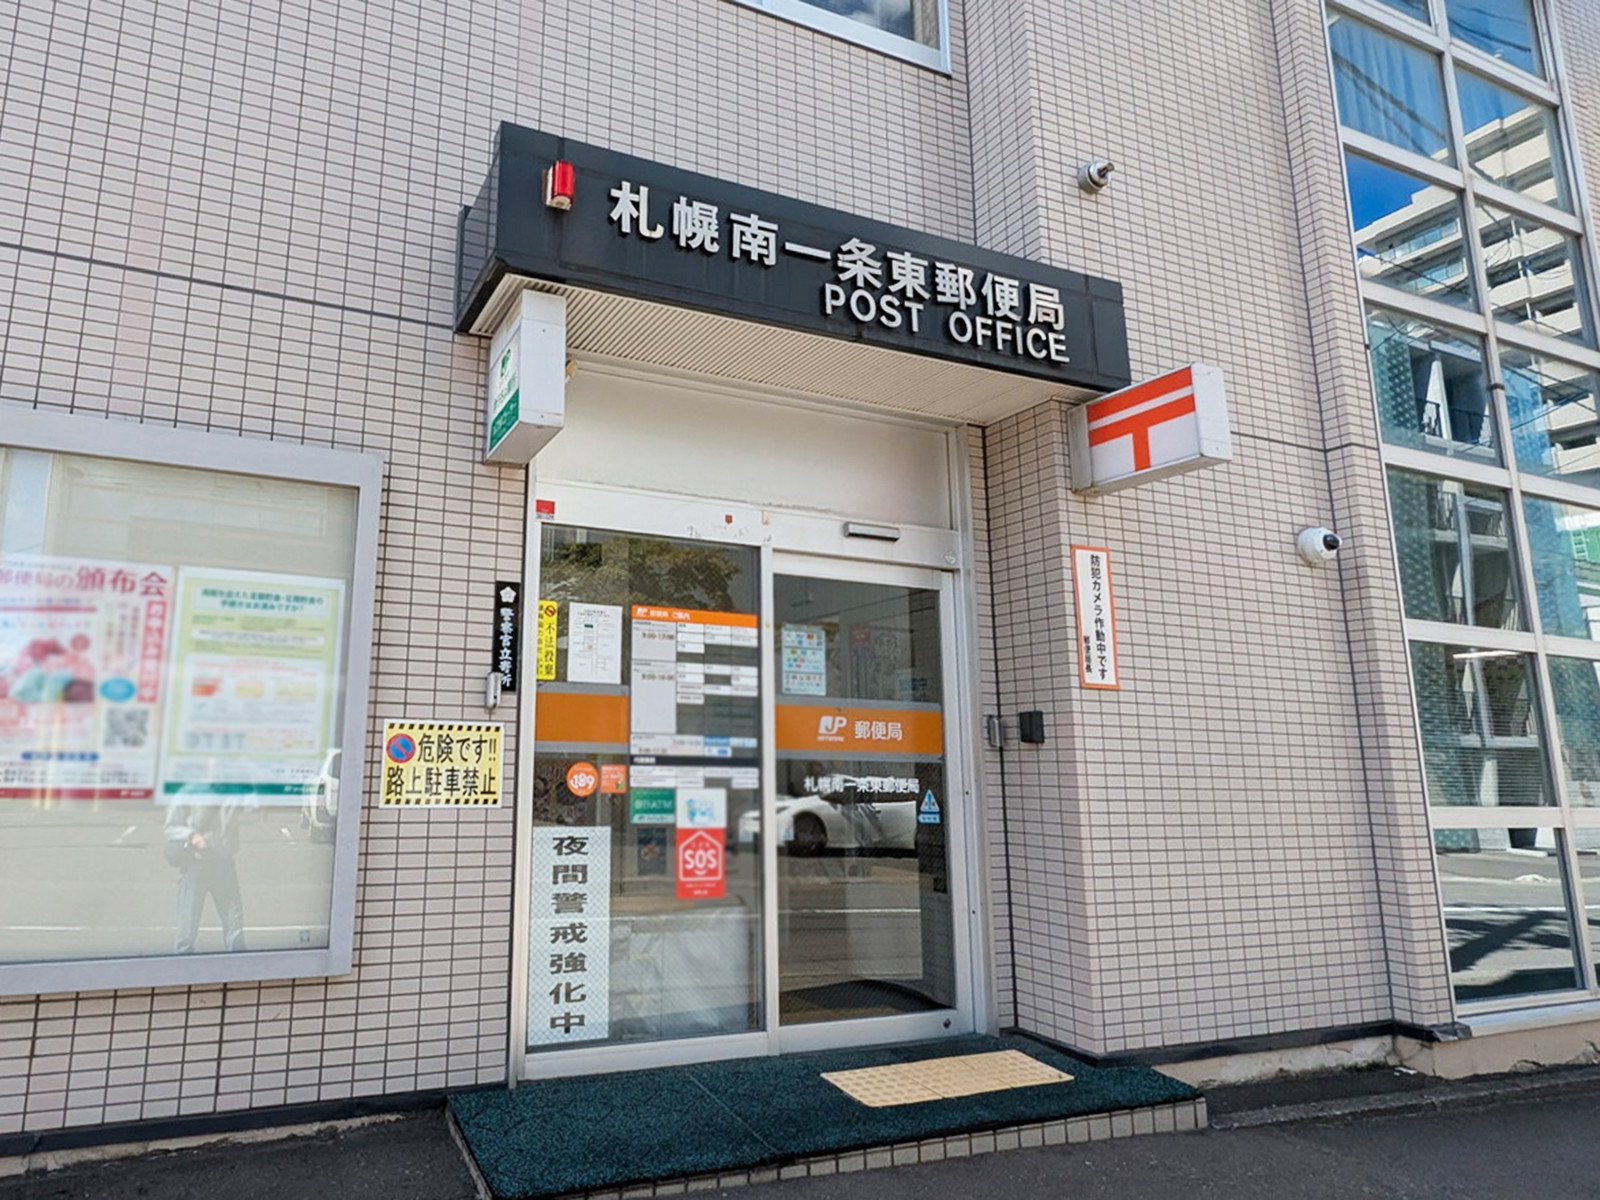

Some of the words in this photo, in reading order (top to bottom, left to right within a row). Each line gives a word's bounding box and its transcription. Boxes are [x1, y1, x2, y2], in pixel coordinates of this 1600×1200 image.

[608, 180, 1065, 332] 札幌南一条東郵便局
[824, 282, 924, 334] POST
[948, 312, 1071, 365] OFFICE
[1090, 553, 1108, 681] 防犯カメラ作動中です
[854, 720, 904, 742] 郵便局
[386, 766, 498, 797] 路上駐車禁止
[684, 847, 718, 870] SOS
[548, 834, 589, 1035] 夜間警戒強化中
